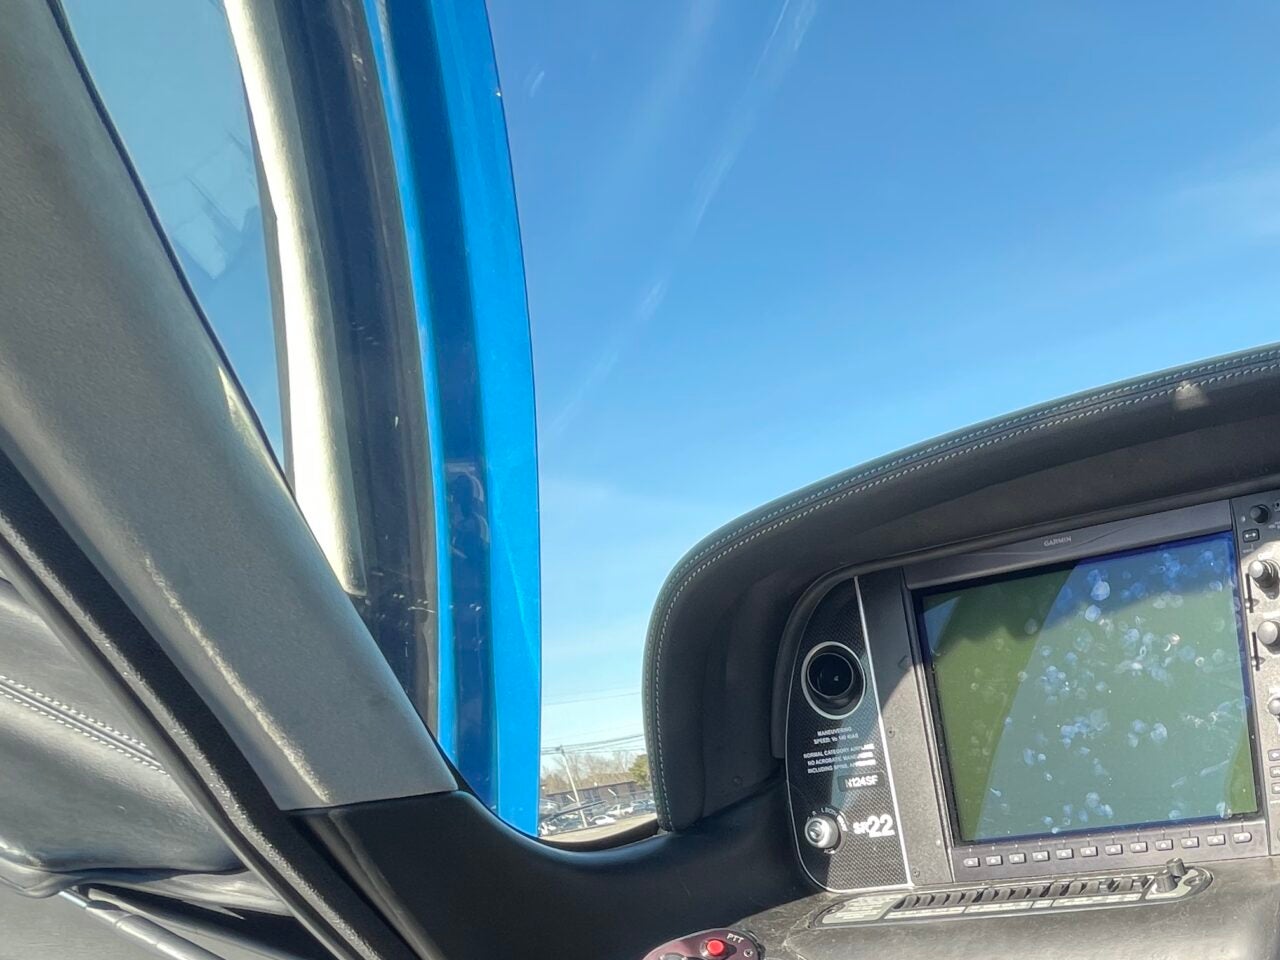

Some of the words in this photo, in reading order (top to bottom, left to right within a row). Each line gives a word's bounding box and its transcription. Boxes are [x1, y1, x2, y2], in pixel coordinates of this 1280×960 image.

[1044, 536, 1072, 547] GARMIN
[845, 775, 878, 788] N124SF
[853, 814, 895, 838] SR22
[726, 933, 744, 943] PTT
